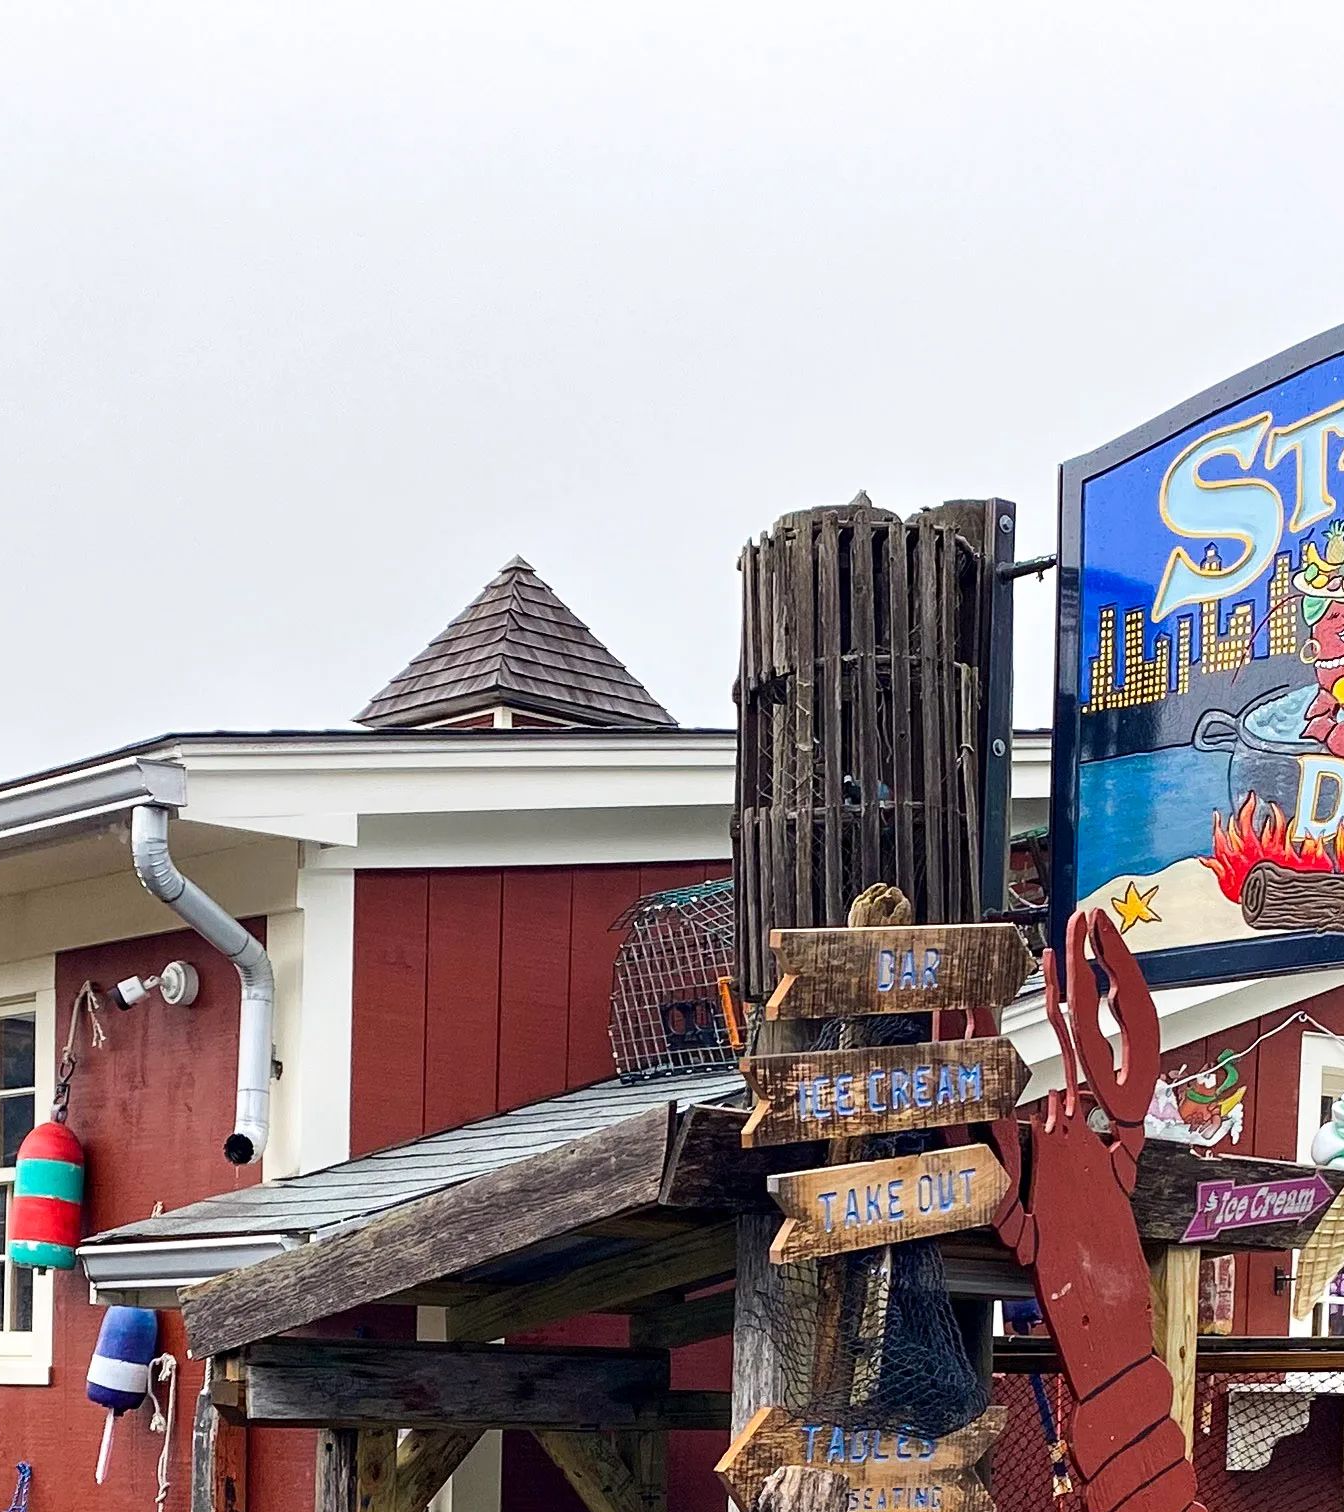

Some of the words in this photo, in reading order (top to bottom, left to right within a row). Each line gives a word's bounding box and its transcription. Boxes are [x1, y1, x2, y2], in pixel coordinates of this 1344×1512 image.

[876, 947, 939, 992] BAR
[798, 1069, 853, 1121] ICE
[867, 1063, 983, 1112] CREAM
[817, 1177, 904, 1234] TAKE
[917, 1167, 977, 1213] OUT
[1215, 1190, 1249, 1224] Ice
[1250, 1186, 1316, 1219] Cream
